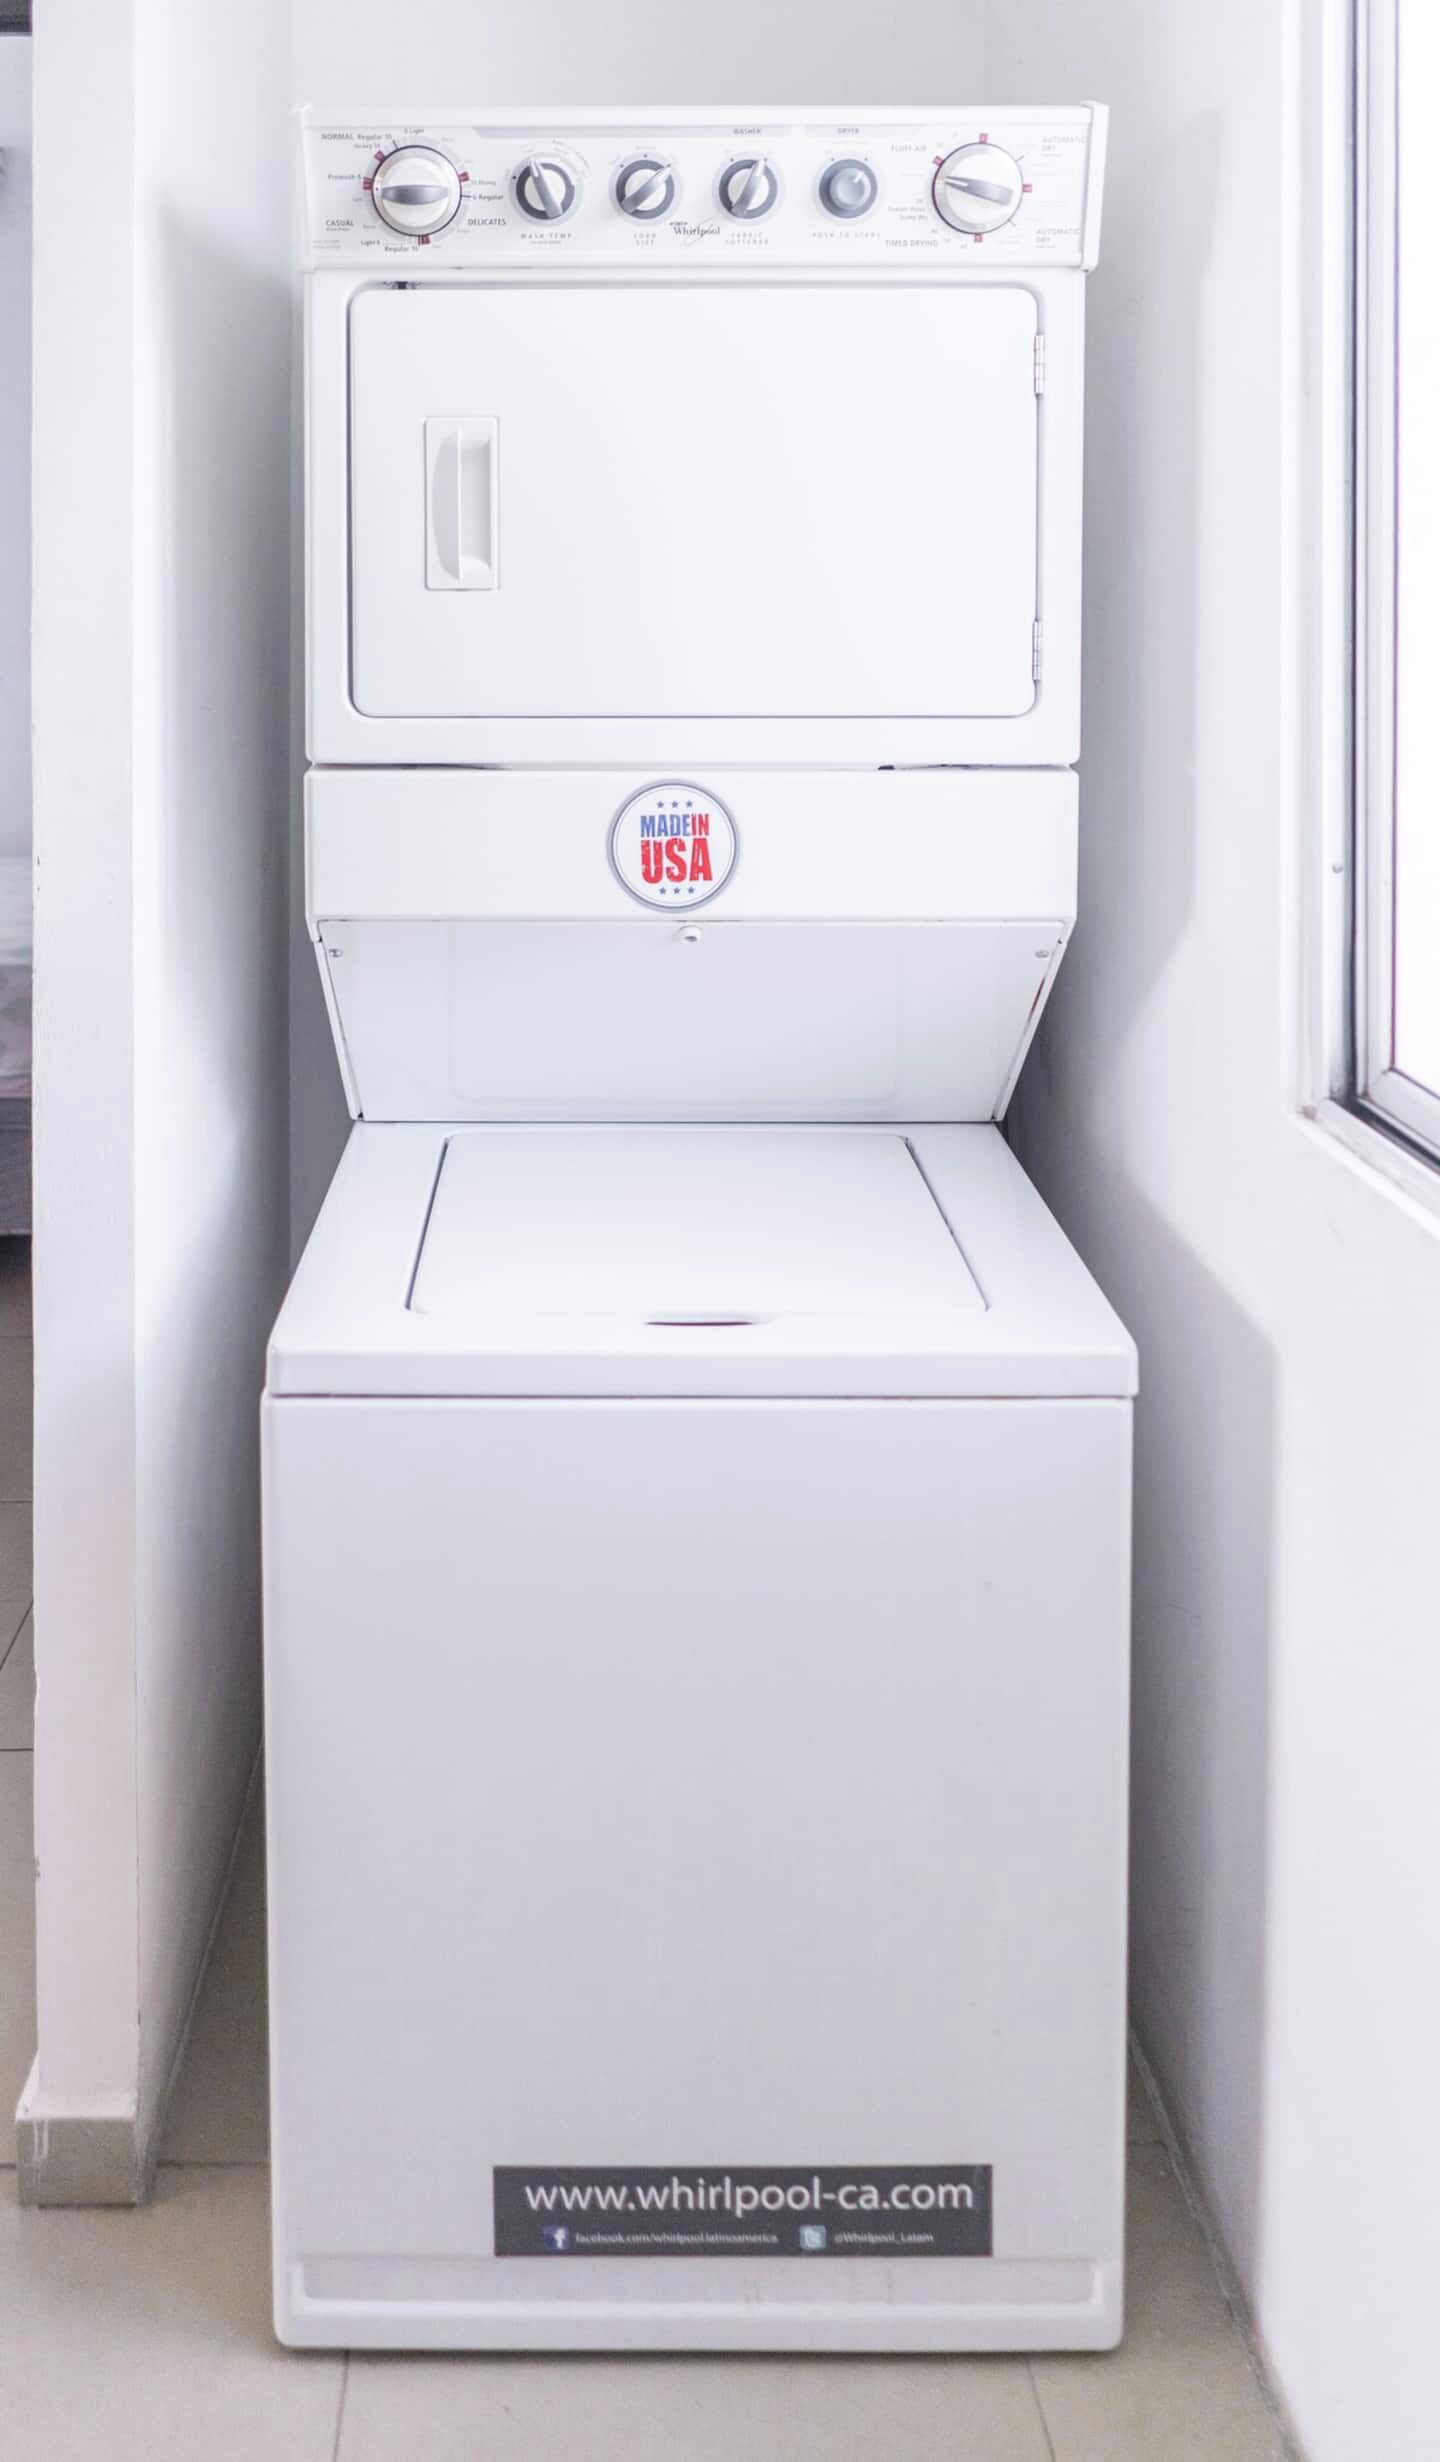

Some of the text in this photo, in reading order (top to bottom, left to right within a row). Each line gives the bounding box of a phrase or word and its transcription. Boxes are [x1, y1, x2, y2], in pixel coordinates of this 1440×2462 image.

[357, 133, 381, 141] Regular
[478, 193, 504, 201] Regular
[325, 219, 354, 227] CASUAL
[467, 218, 506, 226] DELICATES
[673, 225, 721, 238] Whirlpool
[384, 245, 409, 253] Regular
[640, 837, 713, 885] USA
[524, 2175, 974, 2218] www.whirlpool-ca.com
